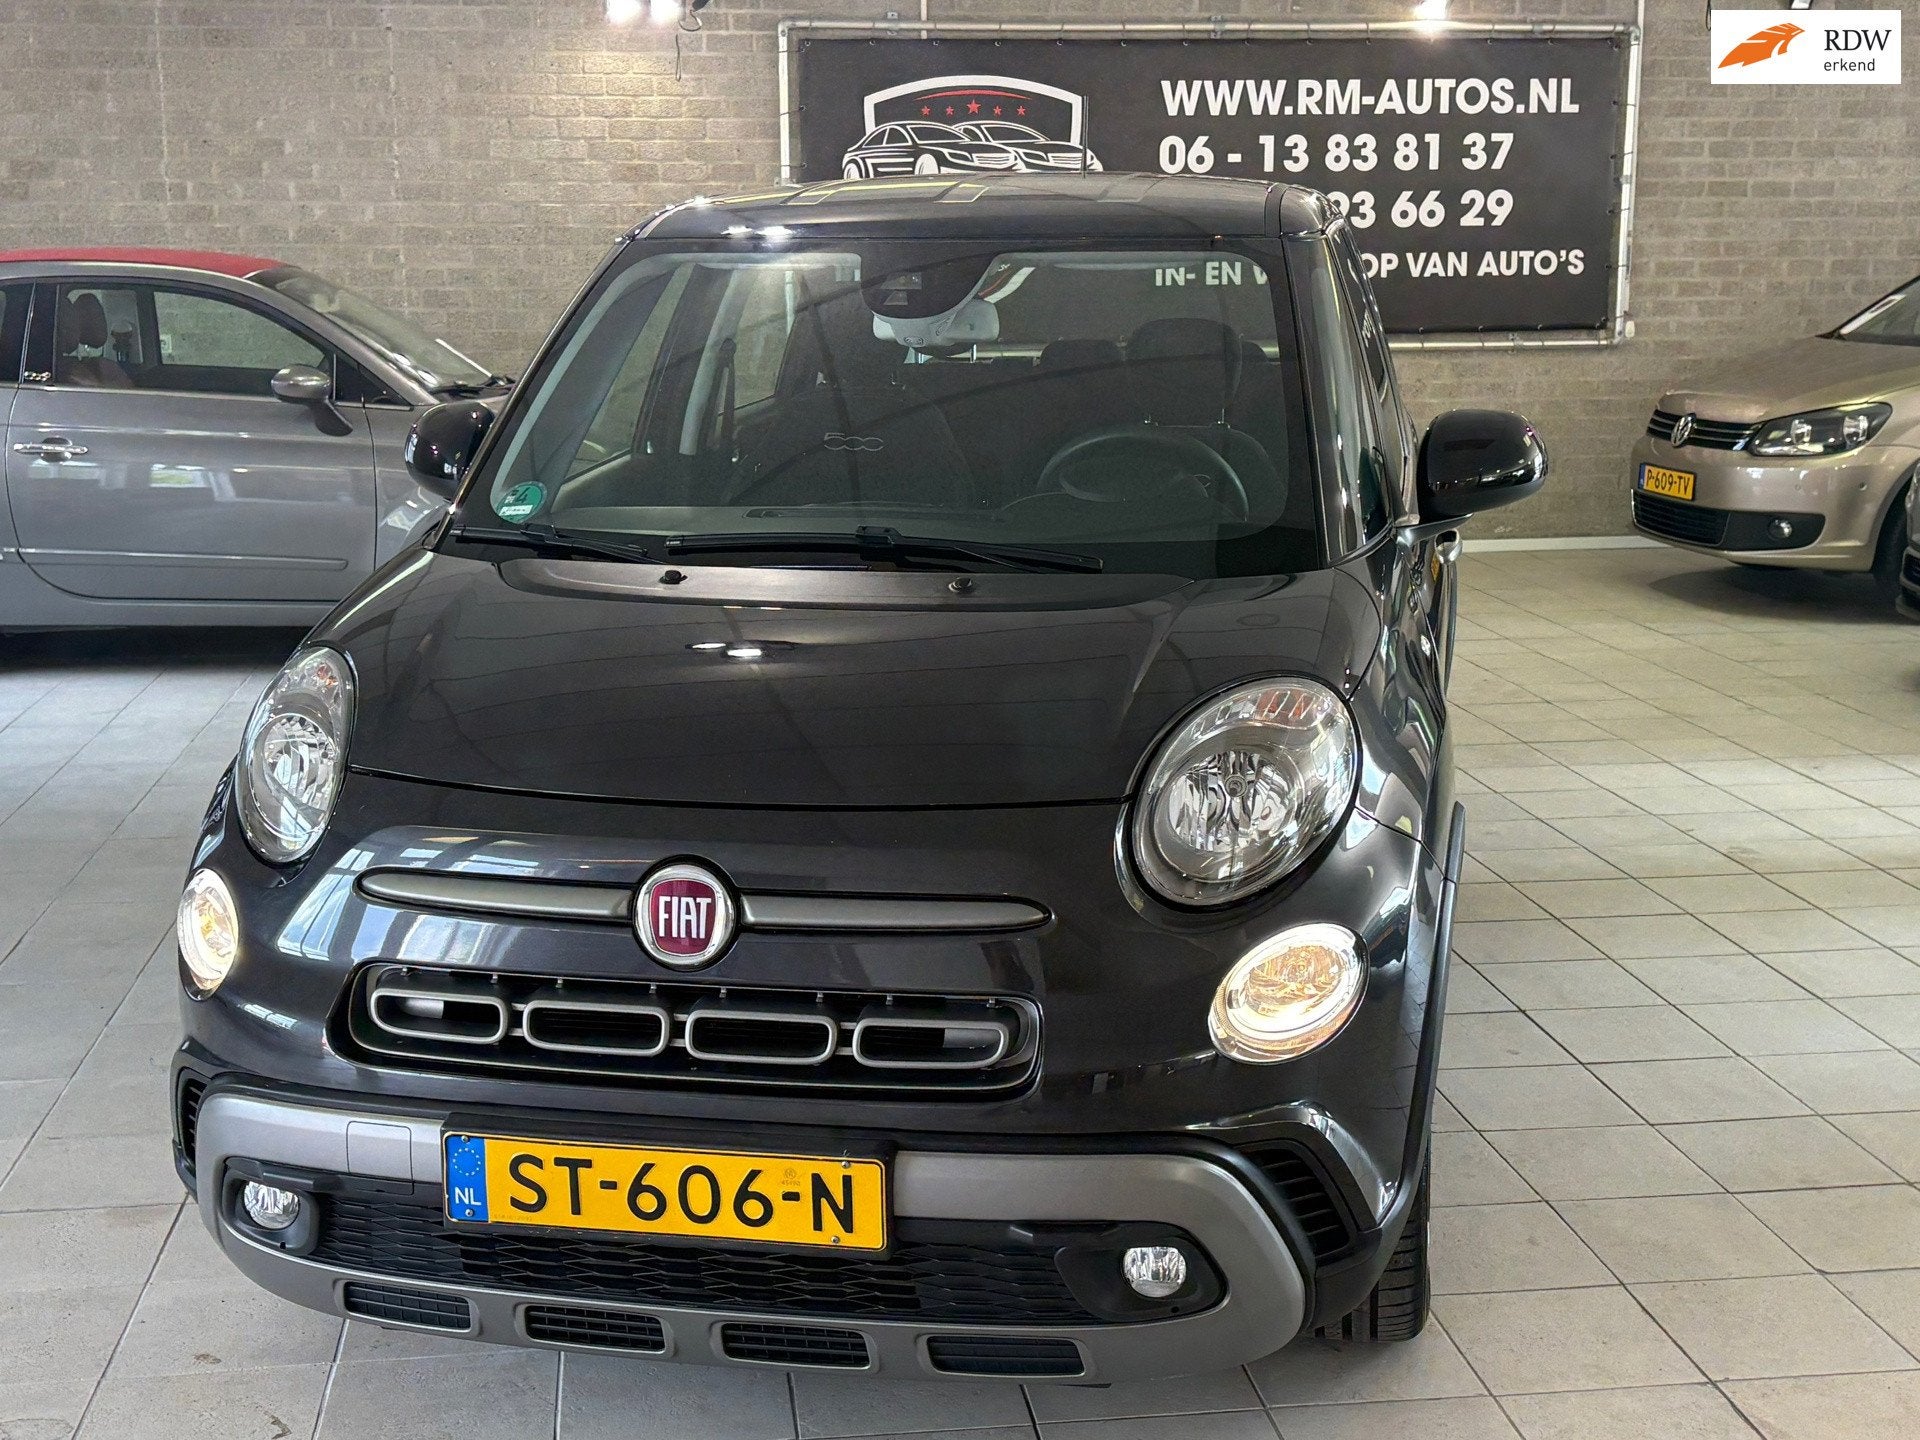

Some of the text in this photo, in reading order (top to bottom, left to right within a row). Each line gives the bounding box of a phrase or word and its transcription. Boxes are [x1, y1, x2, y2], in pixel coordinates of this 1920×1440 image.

[1160, 77, 1581, 116] WWW.RM-AUTOS.NL
[1159, 135, 1215, 174] 06
[1258, 133, 1310, 173] 13
[1324, 133, 1378, 172] 83
[1393, 132, 1440, 171] 81
[1461, 132, 1514, 171] 37
[1390, 190, 1446, 228] 66
[1459, 189, 1514, 227] 29
[1155, 267, 1196, 287] IN-
[1205, 261, 1242, 286] EN
[1405, 251, 1468, 278] VAN
[1476, 249, 1585, 277] AUTO'S
[1646, 468, 1691, 496] P-609-TV
[658, 895, 712, 940] FIAT
[454, 1186, 482, 1206] NL
[508, 1152, 854, 1234] ST-606-N
